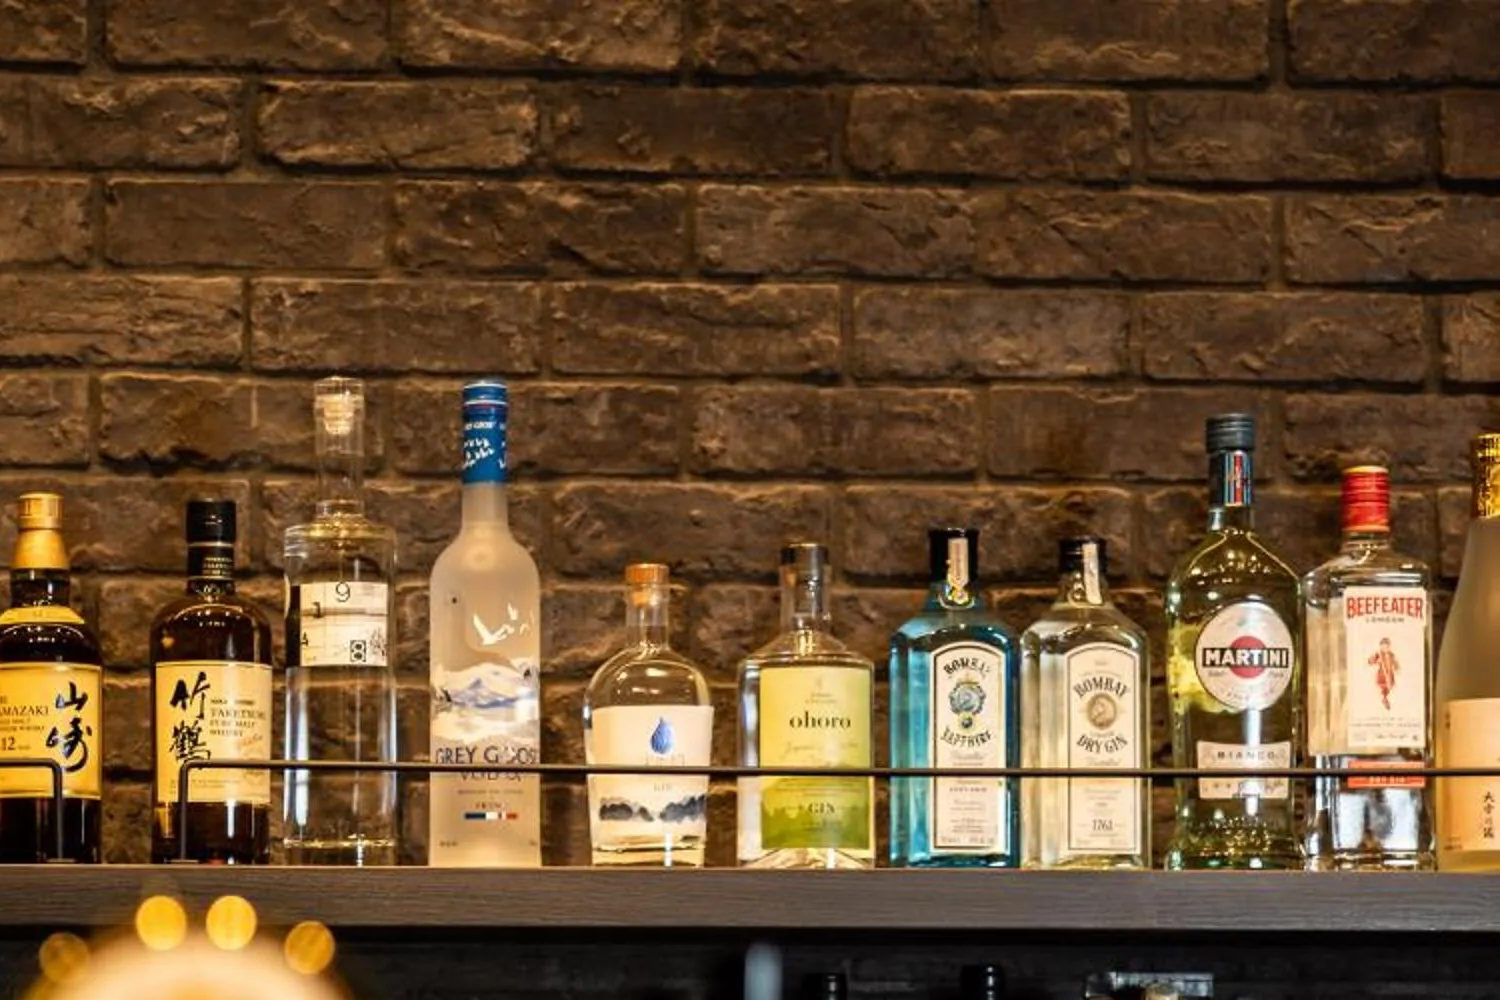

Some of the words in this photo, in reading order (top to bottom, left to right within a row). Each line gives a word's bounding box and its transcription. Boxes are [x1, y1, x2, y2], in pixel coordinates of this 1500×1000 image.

[335, 582, 351, 603] 9
[1347, 596, 1424, 619] BEEFEATER
[1205, 649, 1288, 666] MARTINI
[1073, 676, 1128, 698] BOMBAY
[45, 681, 93, 773] 山崎
[789, 710, 852, 730] ohoro
[1, 736, 16, 751] 12
[1076, 734, 1102, 754] DRY
[1104, 735, 1129, 753] GIN
[435, 746, 477, 765] GREY
